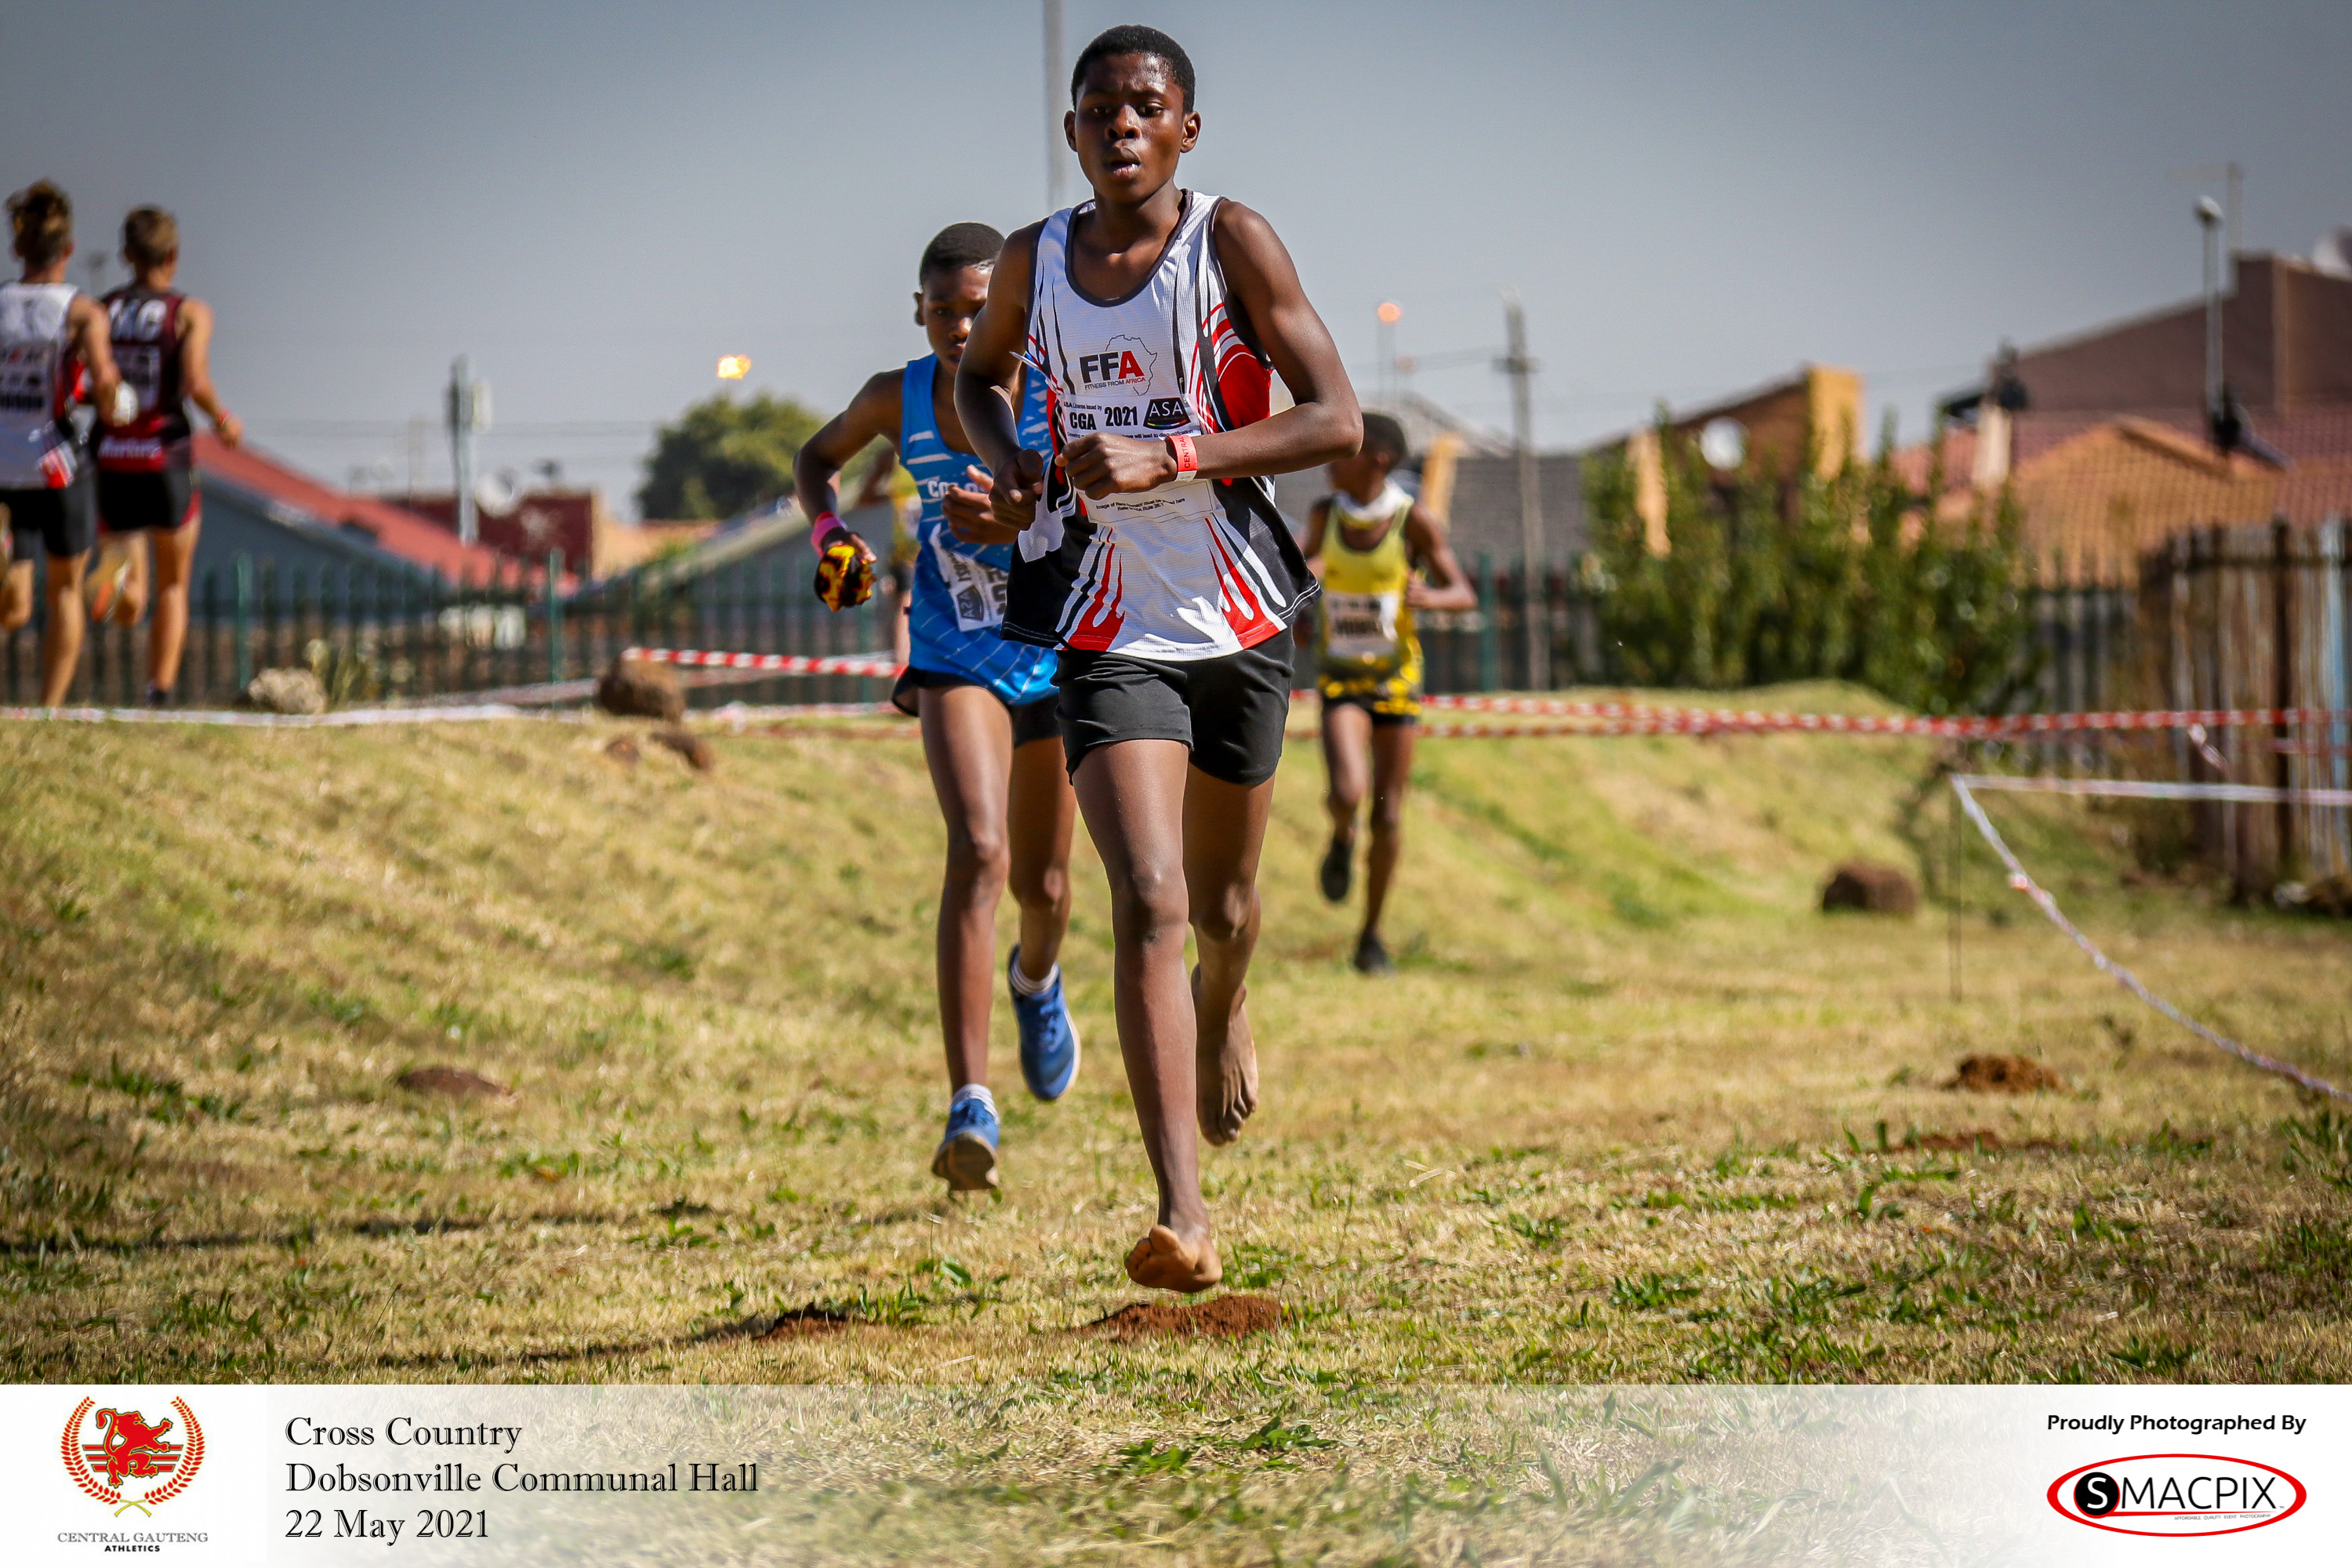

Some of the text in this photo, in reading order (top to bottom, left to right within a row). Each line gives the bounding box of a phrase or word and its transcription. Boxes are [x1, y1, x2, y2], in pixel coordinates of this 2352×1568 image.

[1080, 350, 1145, 383] FFA
[1069, 406, 1138, 430] CGA 2021
[1149, 401, 1183, 417] ASA
